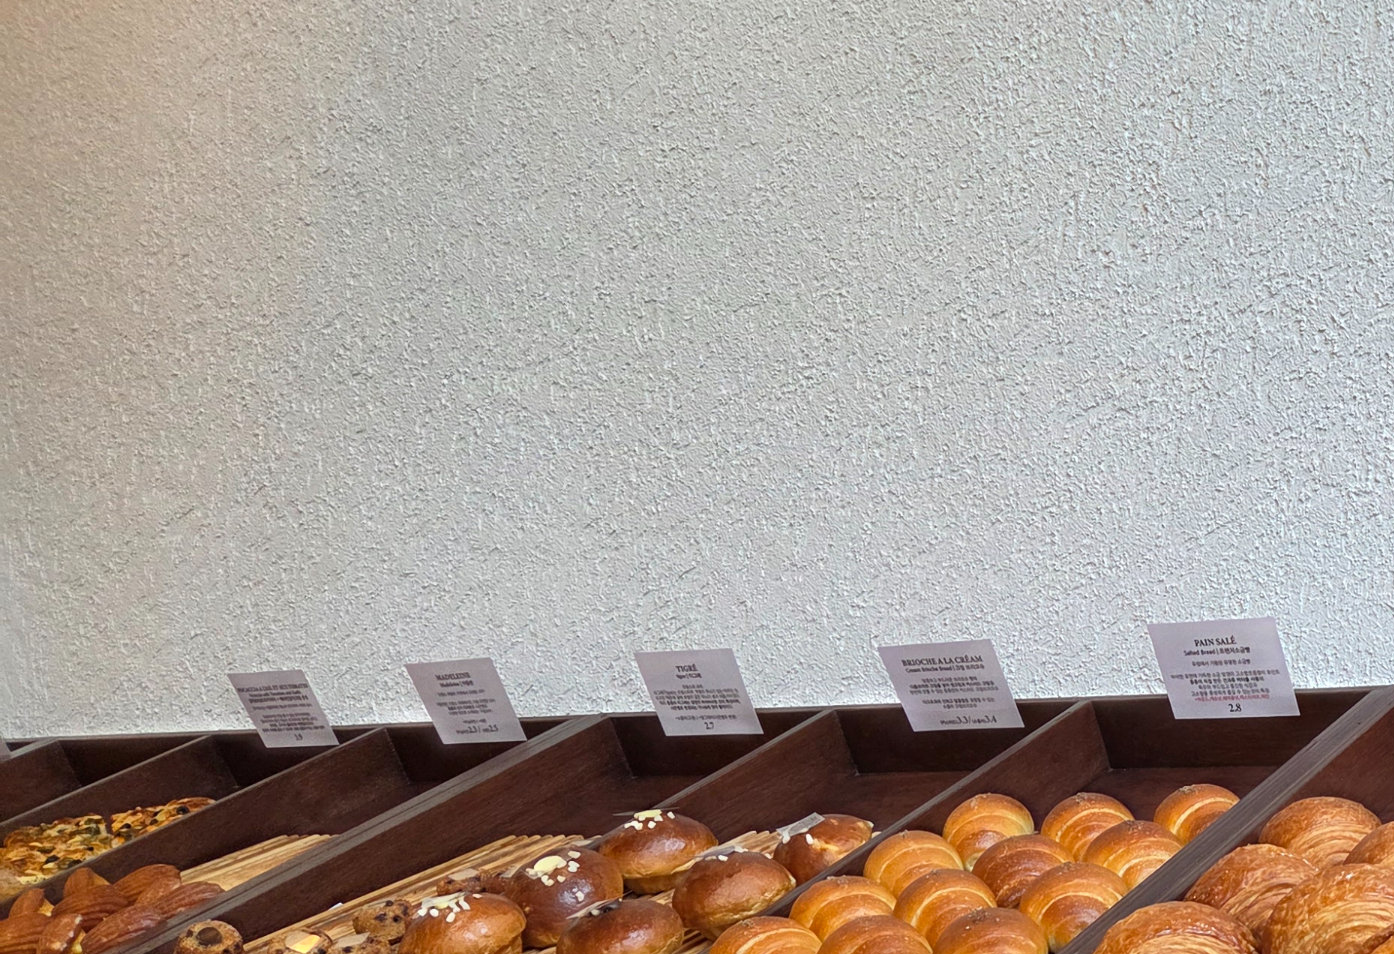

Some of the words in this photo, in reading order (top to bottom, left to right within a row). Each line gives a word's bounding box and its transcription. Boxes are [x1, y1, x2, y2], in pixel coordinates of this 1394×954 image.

[1193, 638, 1215, 647] PAIN
[1215, 634, 1237, 645] SALÉ
[900, 657, 938, 667] BRIOCHE
[937, 657, 944, 665] A
[1228, 702, 1242, 713] 2.8
